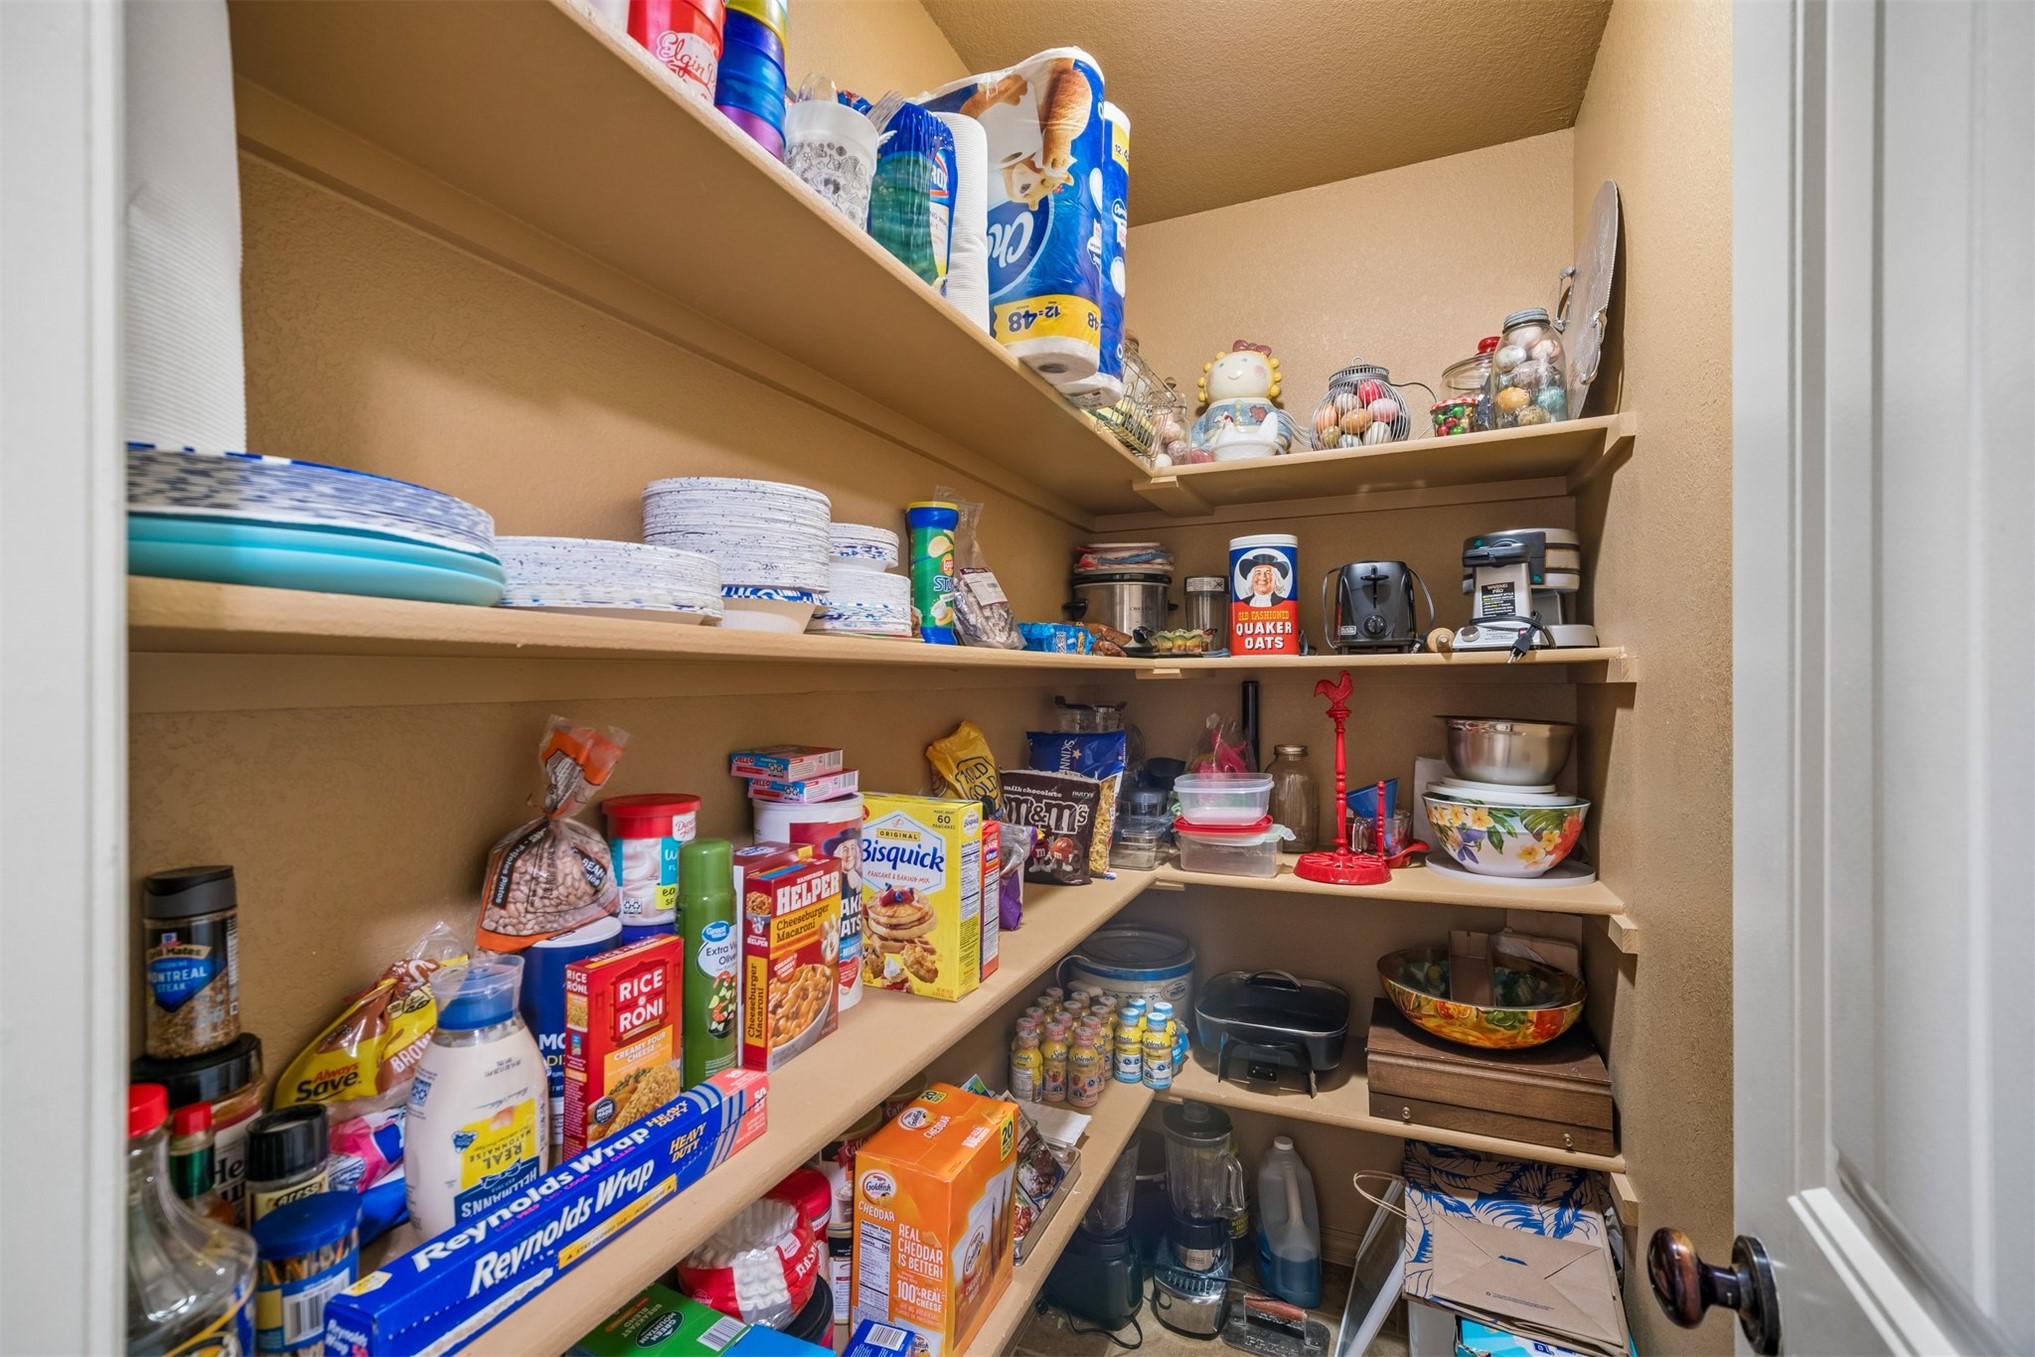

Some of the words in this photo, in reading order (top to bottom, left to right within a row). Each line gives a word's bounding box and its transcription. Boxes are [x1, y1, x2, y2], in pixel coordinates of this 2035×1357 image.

[657, 31, 706, 77] Elgin
[1238, 612, 1249, 621] OLD
[1251, 610, 1289, 620] FASHIONED
[1236, 621, 1292, 636] QUAKER
[1245, 637, 1284, 650] OATS
[1023, 786, 1062, 797] chocolate
[937, 815, 950, 824] 60
[880, 830, 918, 839] ORIGINAL
[862, 838, 945, 872] Bisquick
[495, 867, 509, 904] Pintos
[776, 871, 840, 916] HELPER
[777, 904, 829, 930] Cheeseburger
[777, 919, 816, 943] Macaroni
[706, 945, 729, 956] Extra
[156, 982, 186, 993] STEAK
[566, 970, 587, 983] RICE
[619, 969, 663, 1002] RICE
[748, 963, 757, 1038] Cheeseburger
[619, 998, 663, 1032] RONI
[755, 988, 764, 1039] Macaroni
[614, 1041, 646, 1061] CREAMY
[647, 1032, 666, 1047] FOUR
[627, 1045, 655, 1062] CHEESE
[314, 1062, 359, 1083] Always
[295, 1071, 360, 1103] Save
[669, 1121, 707, 1155] HEAVY
[1002, 1121, 1013, 1145] 20
[483, 1142, 522, 1169] REAL
[671, 1138, 700, 1163] DUTY
[866, 1181, 892, 1193] Goldfish
[412, 1170, 574, 1273] Reynolds
[570, 1127, 649, 1175] Wrap
[858, 1201, 895, 1222] CHEDDAR
[467, 1195, 593, 1298] Reynolds
[594, 1159, 655, 1213] Wrap
[898, 1223, 921, 1242] REAL
[898, 1238, 943, 1265] CHEDDAR
[898, 1253, 907, 1267] IS
[908, 1258, 943, 1280] BETTER!
[897, 1280, 920, 1303] 100%
[921, 1288, 943, 1304] REAL
[916, 1298, 943, 1313] CHEESE
[622, 1303, 662, 1337] BREAKFAST
[623, 1307, 649, 1331] BLEND
[639, 1312, 676, 1345] MOUNTAIN
[652, 1318, 677, 1342] GREEN
[327, 1319, 368, 1348] Reynolds
